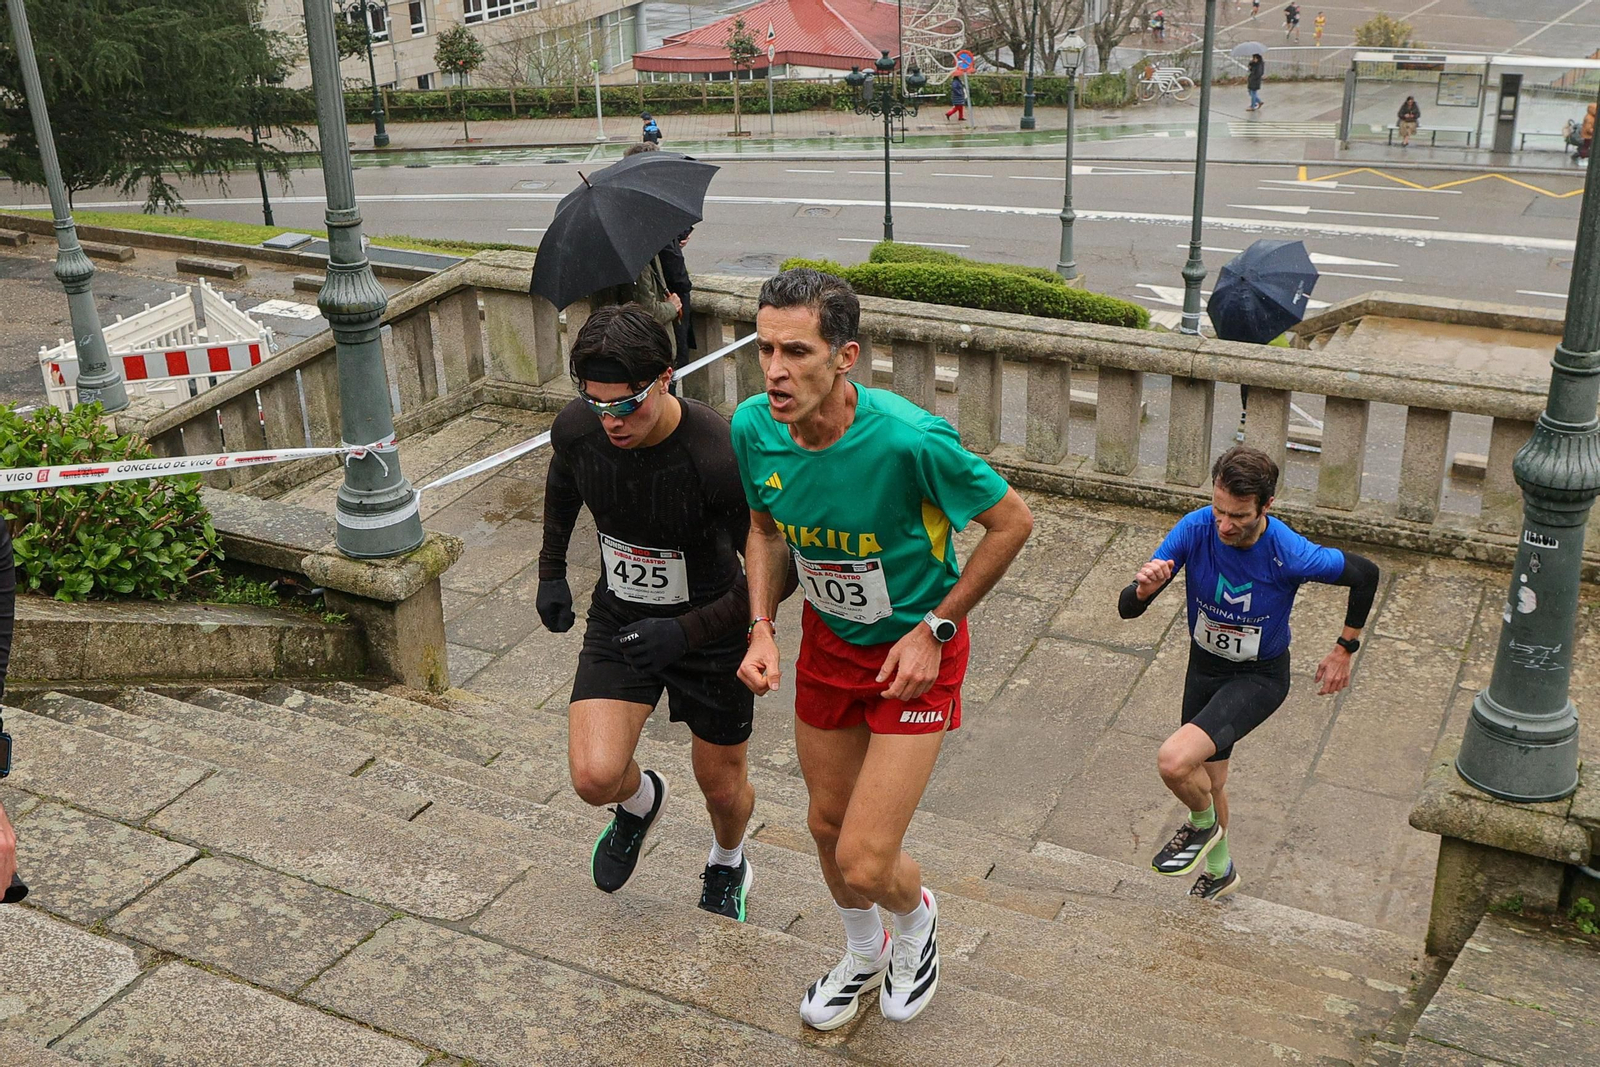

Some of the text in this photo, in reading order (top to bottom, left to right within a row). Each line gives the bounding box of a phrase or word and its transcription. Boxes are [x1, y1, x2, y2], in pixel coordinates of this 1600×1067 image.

[116, 459, 214, 473] CONCELLO DE VIGO
[6, 472, 33, 482] VIGO
[774, 519, 883, 557] BIKILA
[613, 550, 632, 560] SUBIDA
[613, 560, 669, 588] 425
[834, 572, 861, 580] CASTRO
[807, 576, 868, 607] 103
[1196, 597, 1235, 621] MARINA
[1204, 629, 1242, 654] 181
[899, 710, 944, 723] BIKILA
